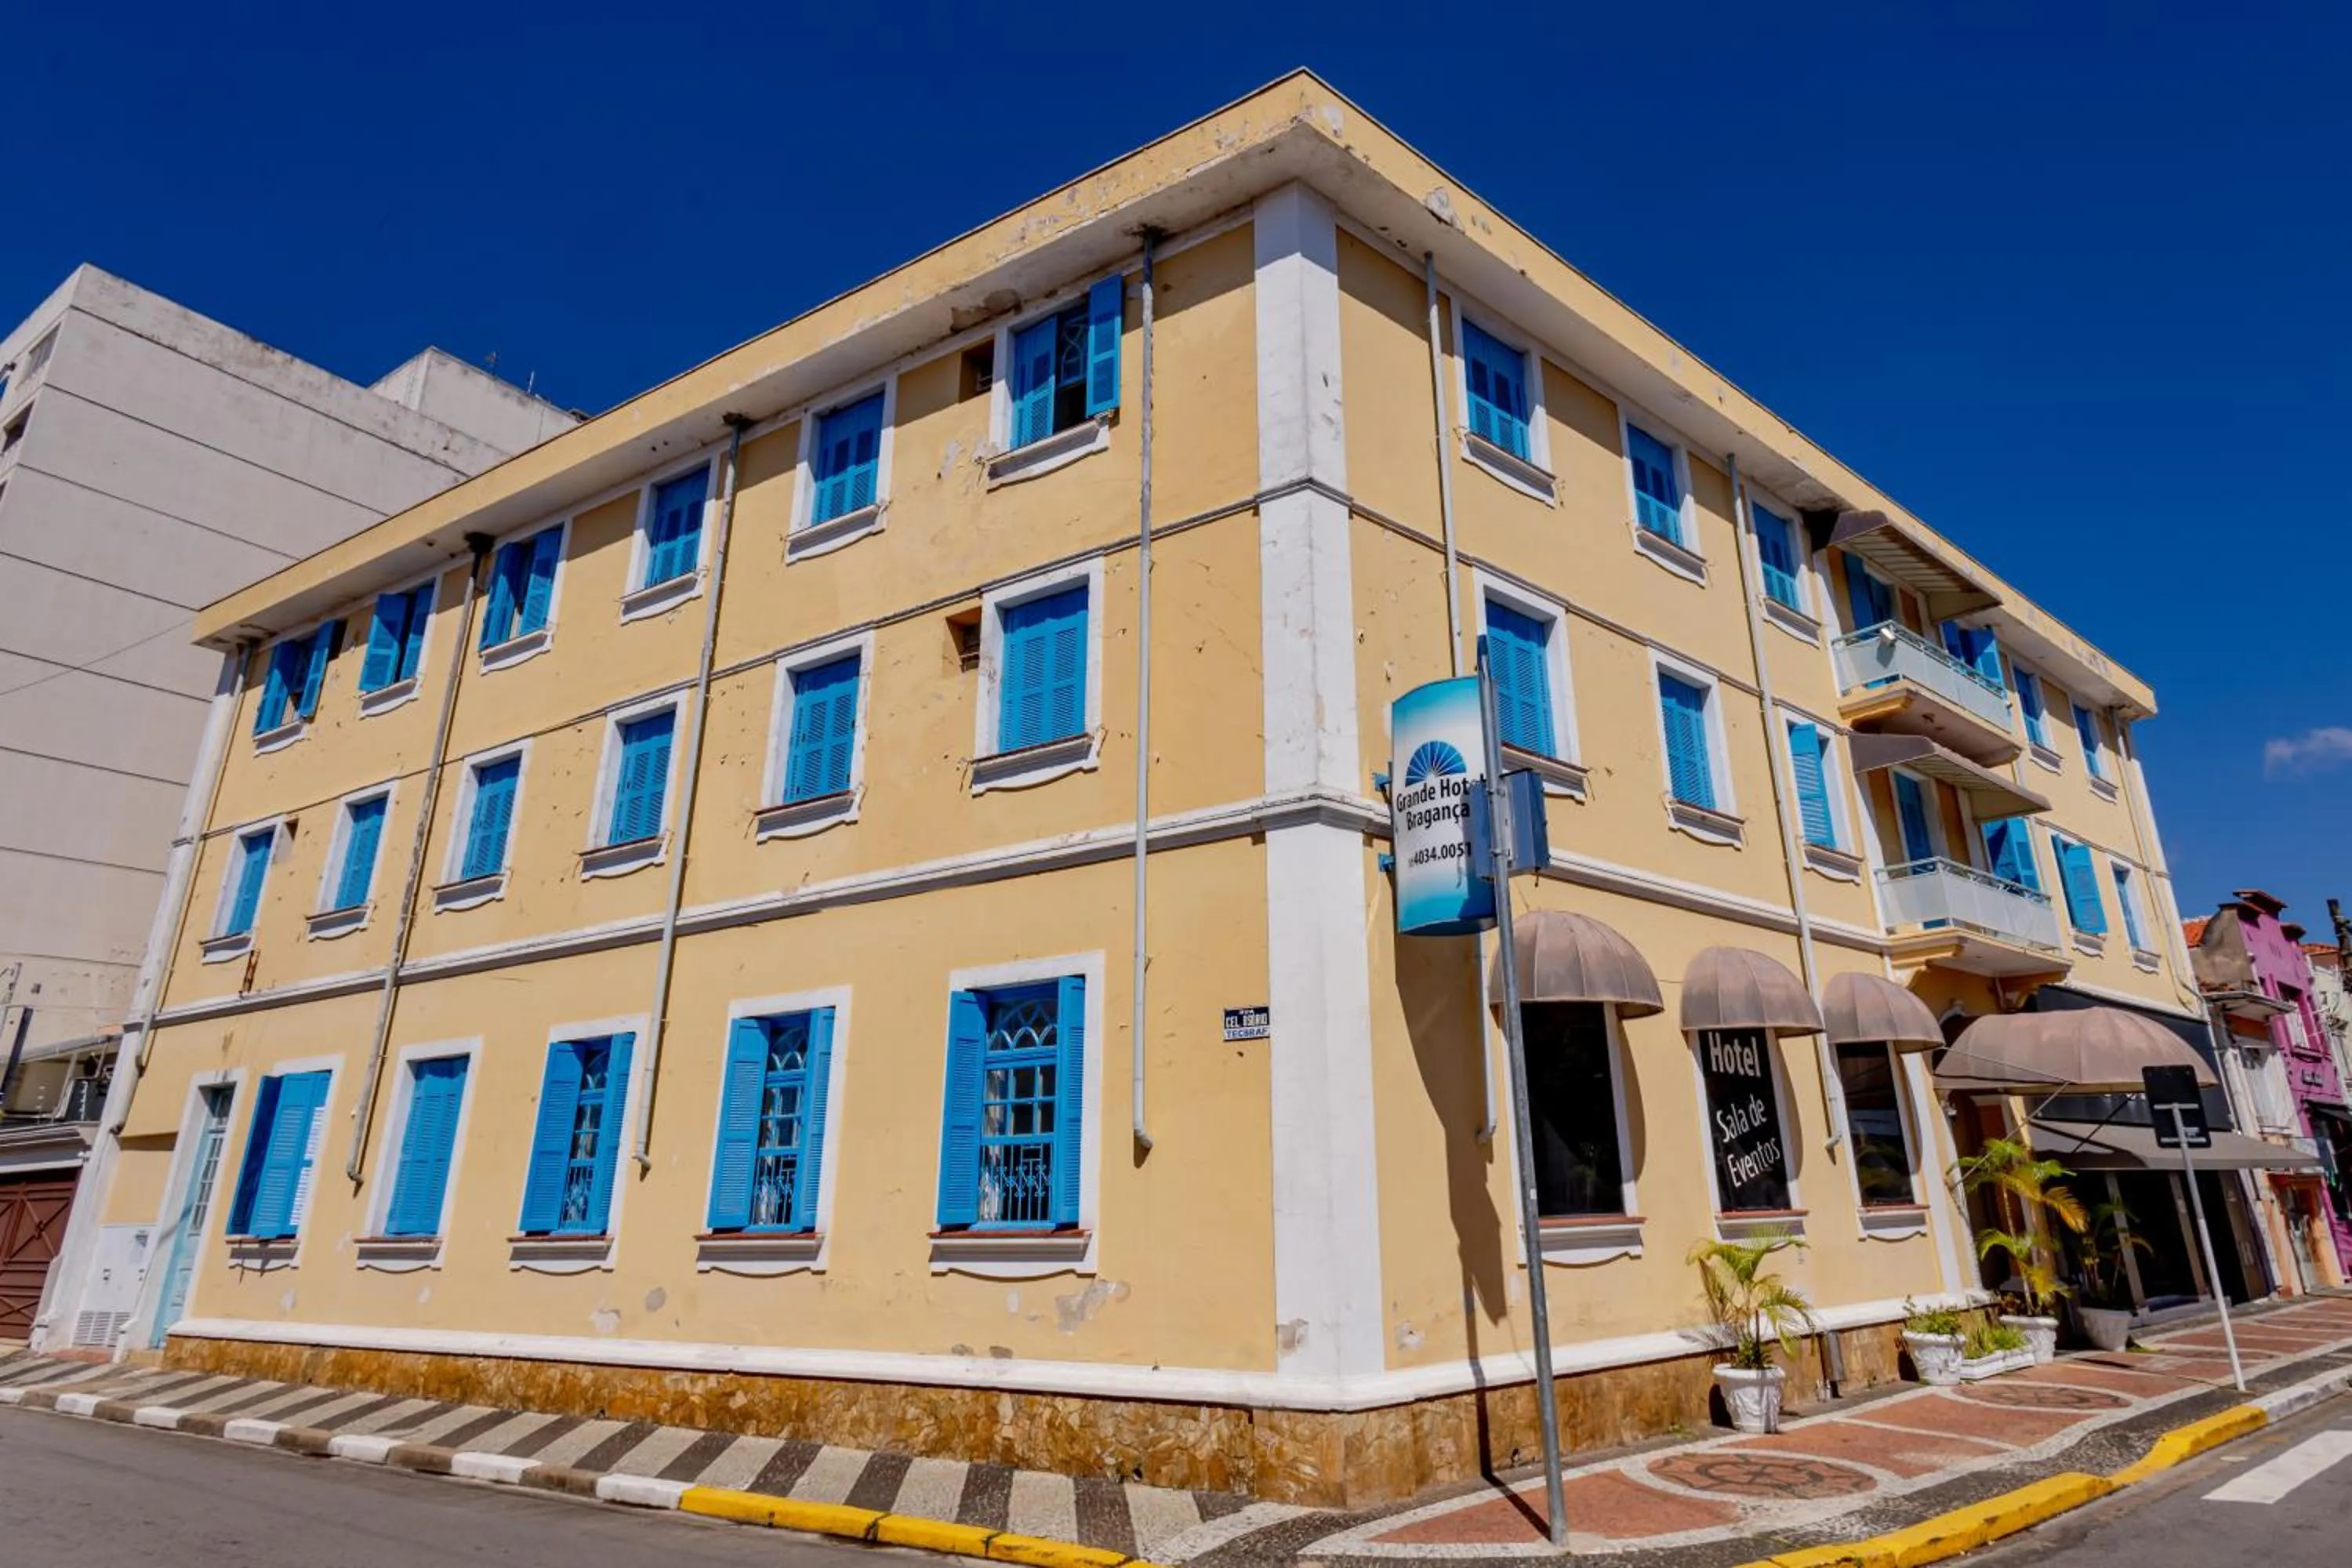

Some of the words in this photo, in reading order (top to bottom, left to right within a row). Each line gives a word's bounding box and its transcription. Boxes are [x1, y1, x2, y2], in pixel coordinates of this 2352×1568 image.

[1396, 783, 1436, 812] Grande
[1440, 773, 1486, 798] Hot
[1406, 802, 1470, 831] Bragança
[1708, 1031, 1762, 1078] Hotel
[1716, 1102, 1750, 1142] Sala
[1749, 1094, 1767, 1127] de
[1727, 1137, 1780, 1188] Eventos
